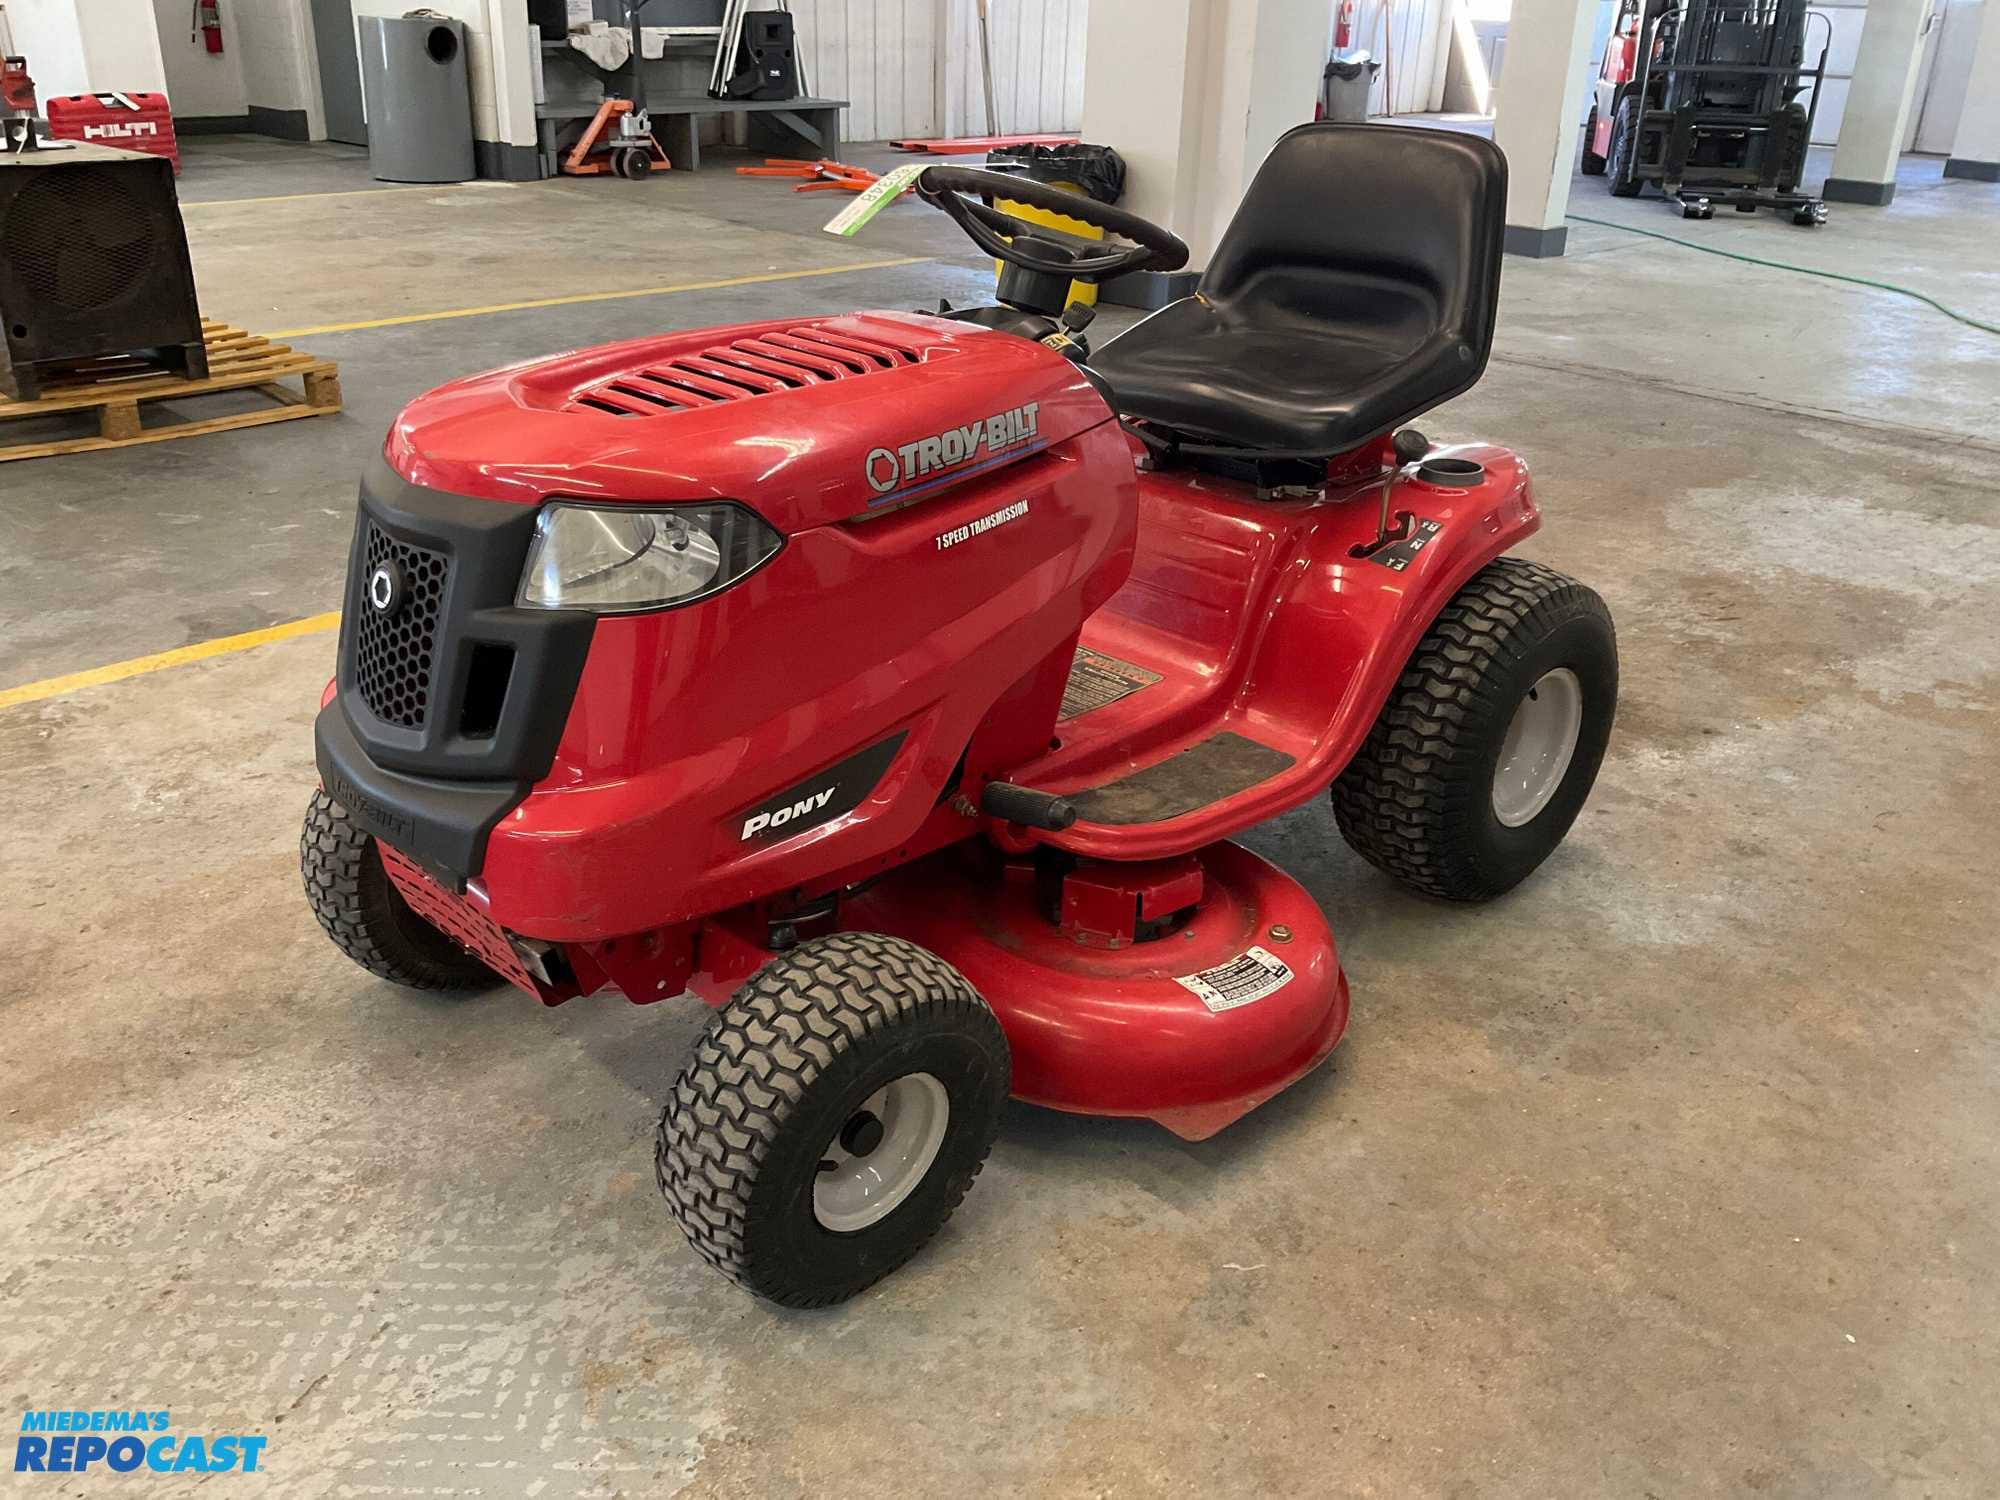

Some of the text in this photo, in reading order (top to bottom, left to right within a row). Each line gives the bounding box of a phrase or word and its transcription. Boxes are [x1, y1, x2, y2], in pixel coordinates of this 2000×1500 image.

[83, 122, 157, 139] HILTI
[898, 402, 1040, 480] TROY-BILT
[935, 499, 1029, 551] 7 SPEED TRANSMISSION
[741, 786, 836, 841] PONY
